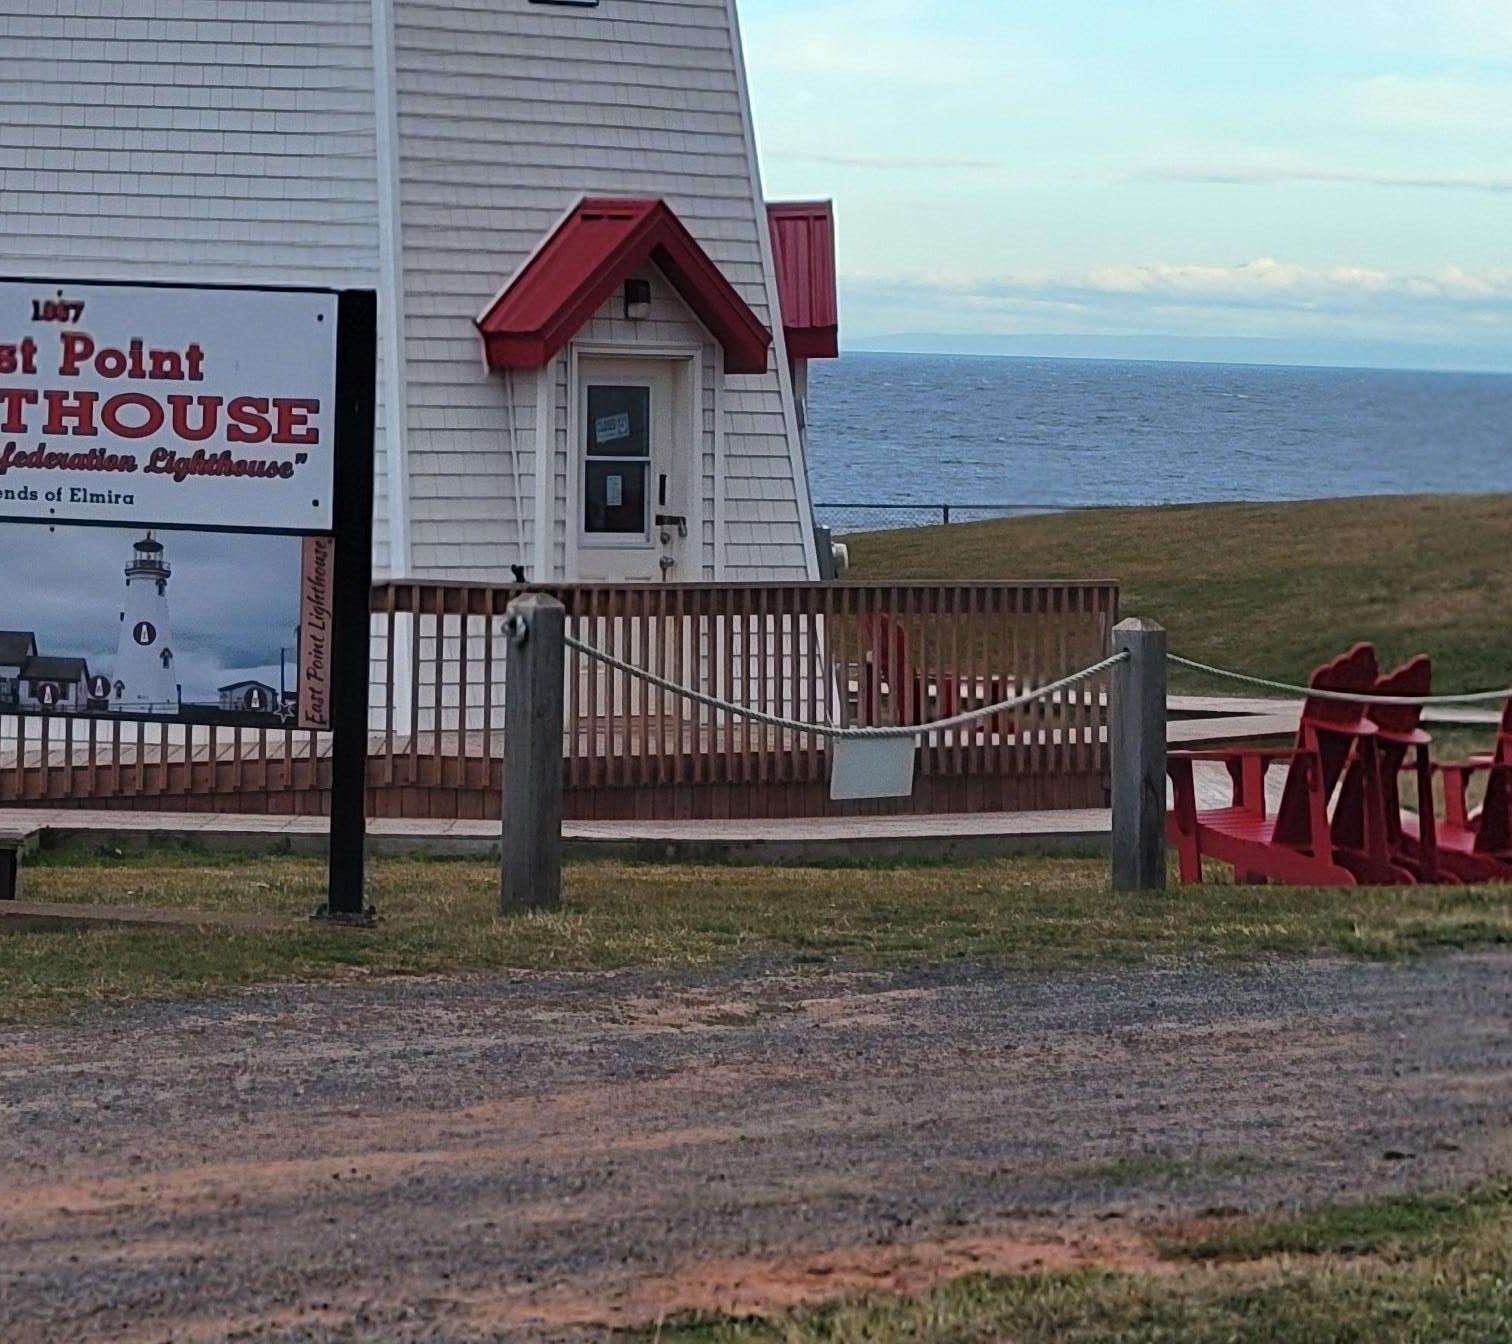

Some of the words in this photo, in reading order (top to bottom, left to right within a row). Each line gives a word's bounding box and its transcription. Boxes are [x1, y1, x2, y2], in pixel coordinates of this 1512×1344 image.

[58, 331, 205, 381] Point
[143, 446, 308, 483] Lighthouse"
[44, 486, 64, 502] of
[69, 487, 135, 506] Elmira
[306, 539, 332, 632] Lighthouse
[305, 634, 325, 683] Point
[304, 688, 327, 726] East
